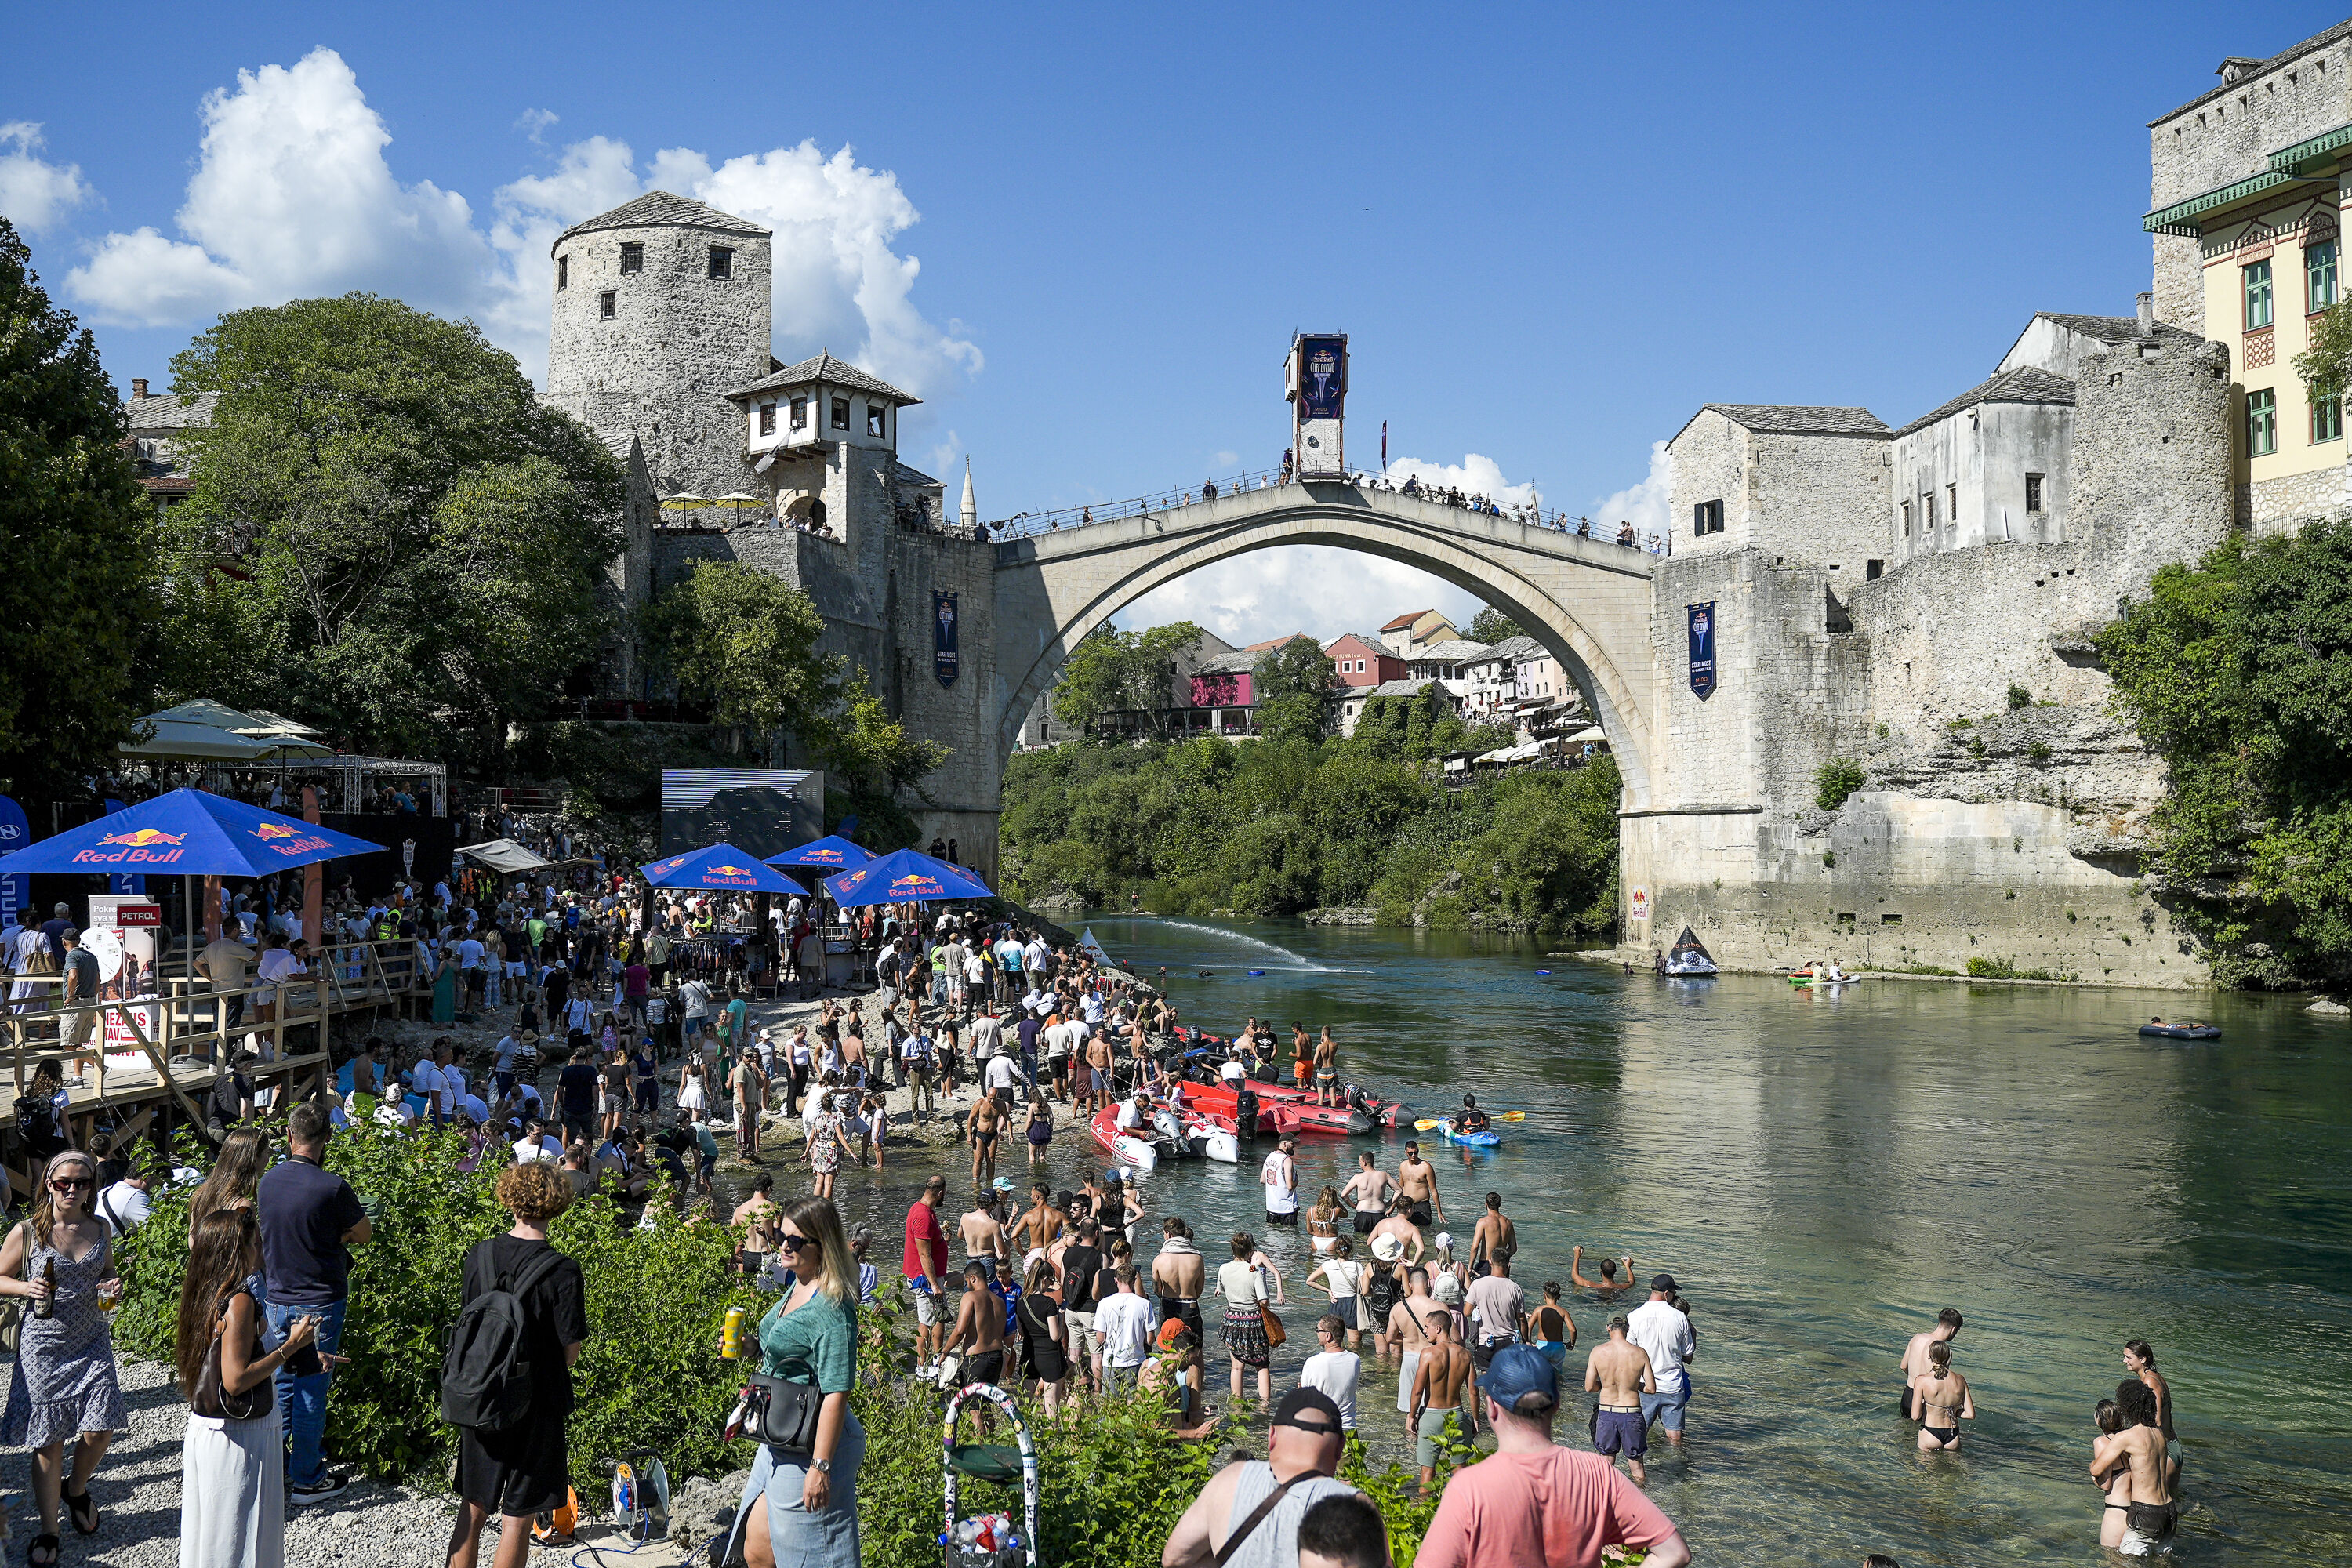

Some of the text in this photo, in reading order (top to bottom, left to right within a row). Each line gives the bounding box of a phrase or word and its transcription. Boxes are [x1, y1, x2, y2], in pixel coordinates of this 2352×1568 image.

[1310, 362, 1335, 373] CLIFF DIVING
[269, 836, 334, 856] Red Bull
[72, 848, 185, 862] Red Bull
[702, 875, 758, 886] Red Bull
[888, 885, 945, 898] Red Bull
[1266, 1168, 1278, 1186] 91
